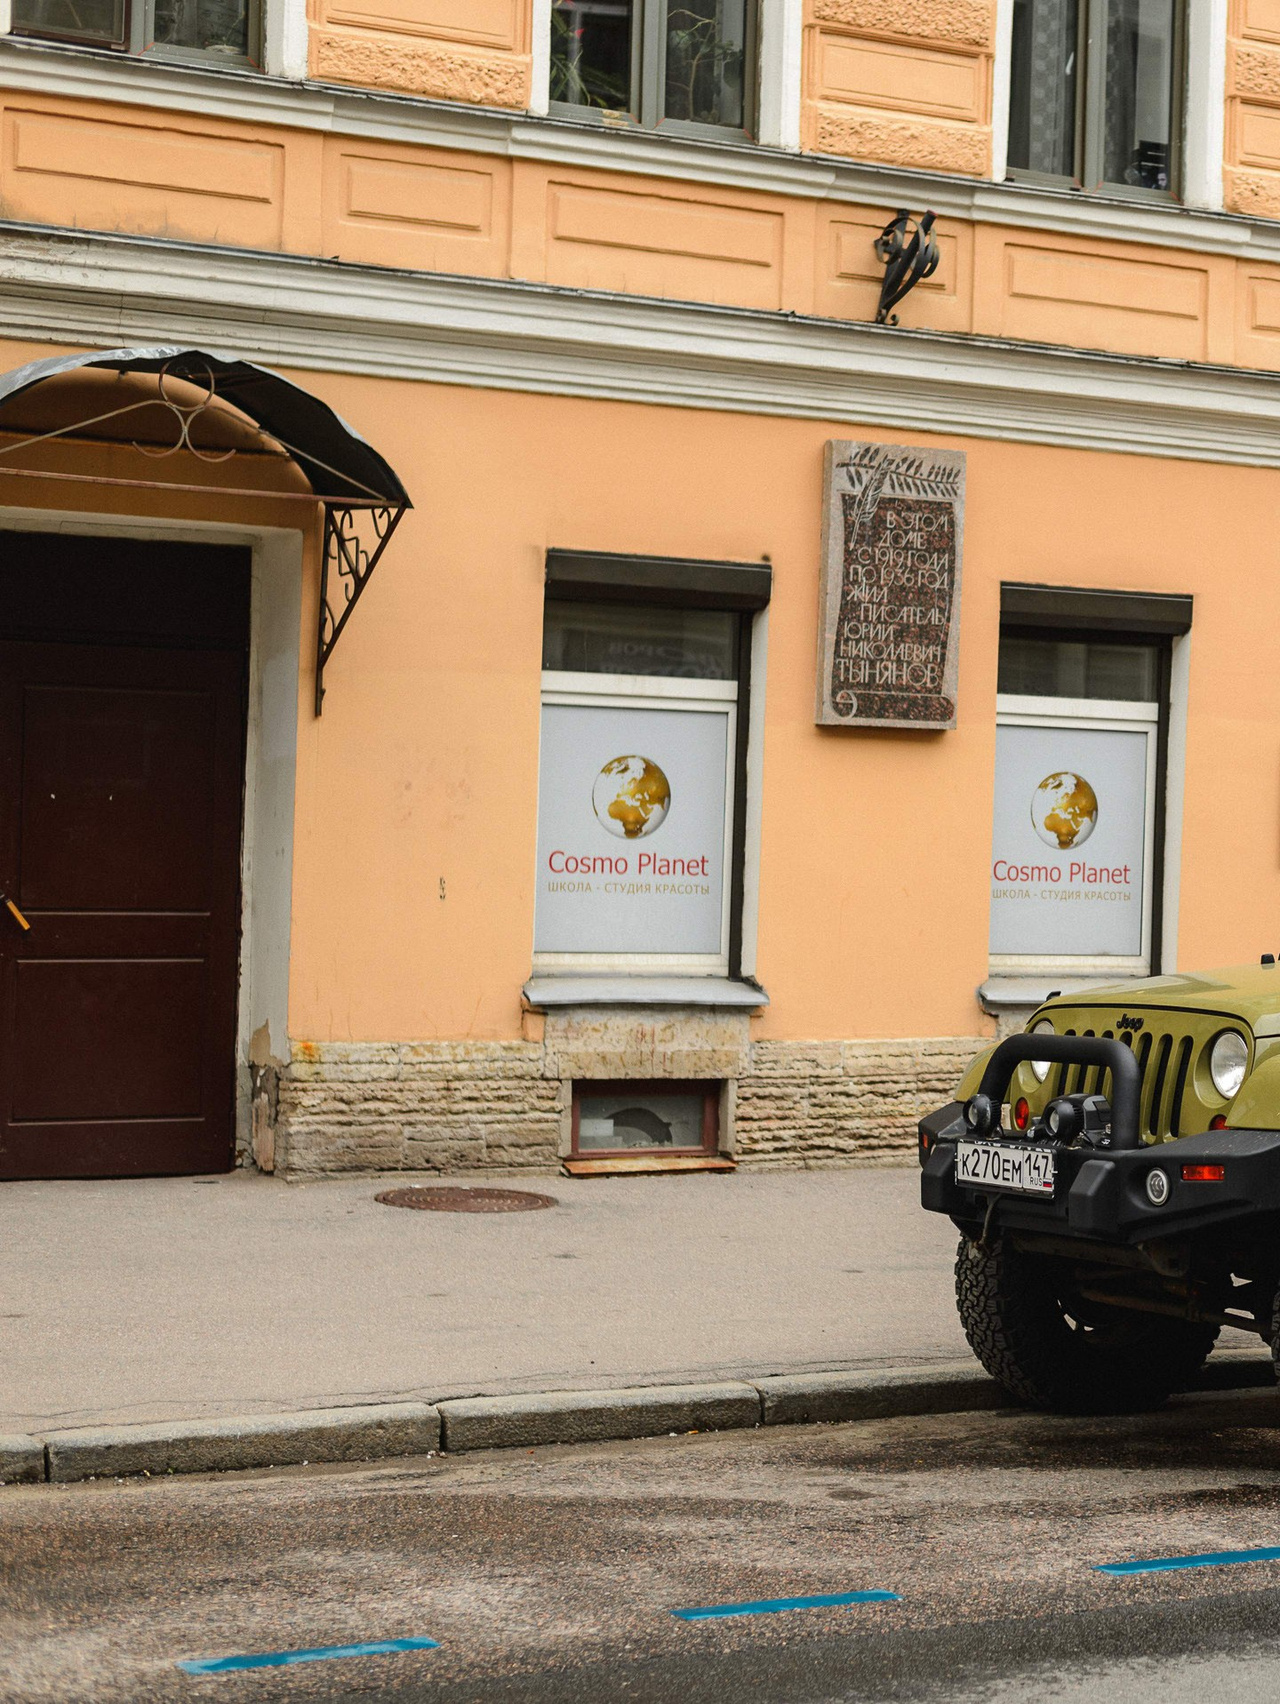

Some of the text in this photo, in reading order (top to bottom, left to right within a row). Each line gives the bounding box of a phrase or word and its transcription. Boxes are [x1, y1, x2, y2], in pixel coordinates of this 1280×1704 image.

[886, 511, 948, 532] В ЭТОМ
[879, 530, 927, 549] ДОМЕ
[858, 546, 949, 571] С 1919 ГОДА
[850, 565, 949, 590] ПО 1936 ГОД
[846, 584, 888, 602] ЖИЛ
[860, 603, 945, 625] ПИСАТЕЛЬ
[840, 640, 941, 662] НИКОЛАЕВИЧ
[836, 658, 939, 686] ТЫНЯНОВ
[549, 851, 709, 877] Cosmo Planet
[993, 860, 1131, 885] Cosmo Planet
[548, 881, 592, 893] ШКОЛА
[604, 882, 650, 895] СТУДИЯ
[655, 883, 710, 895] КРАСОТЫ
[992, 889, 1031, 900] ШКОЛА
[1041, 890, 1081, 901] СТУДИЯ
[1085, 890, 1131, 901] КРАСОТЫ
[1116, 1013, 1144, 1033] Jeep
[1025, 1153, 1049, 1178] 147
[1030, 1177, 1043, 1187] RUS
